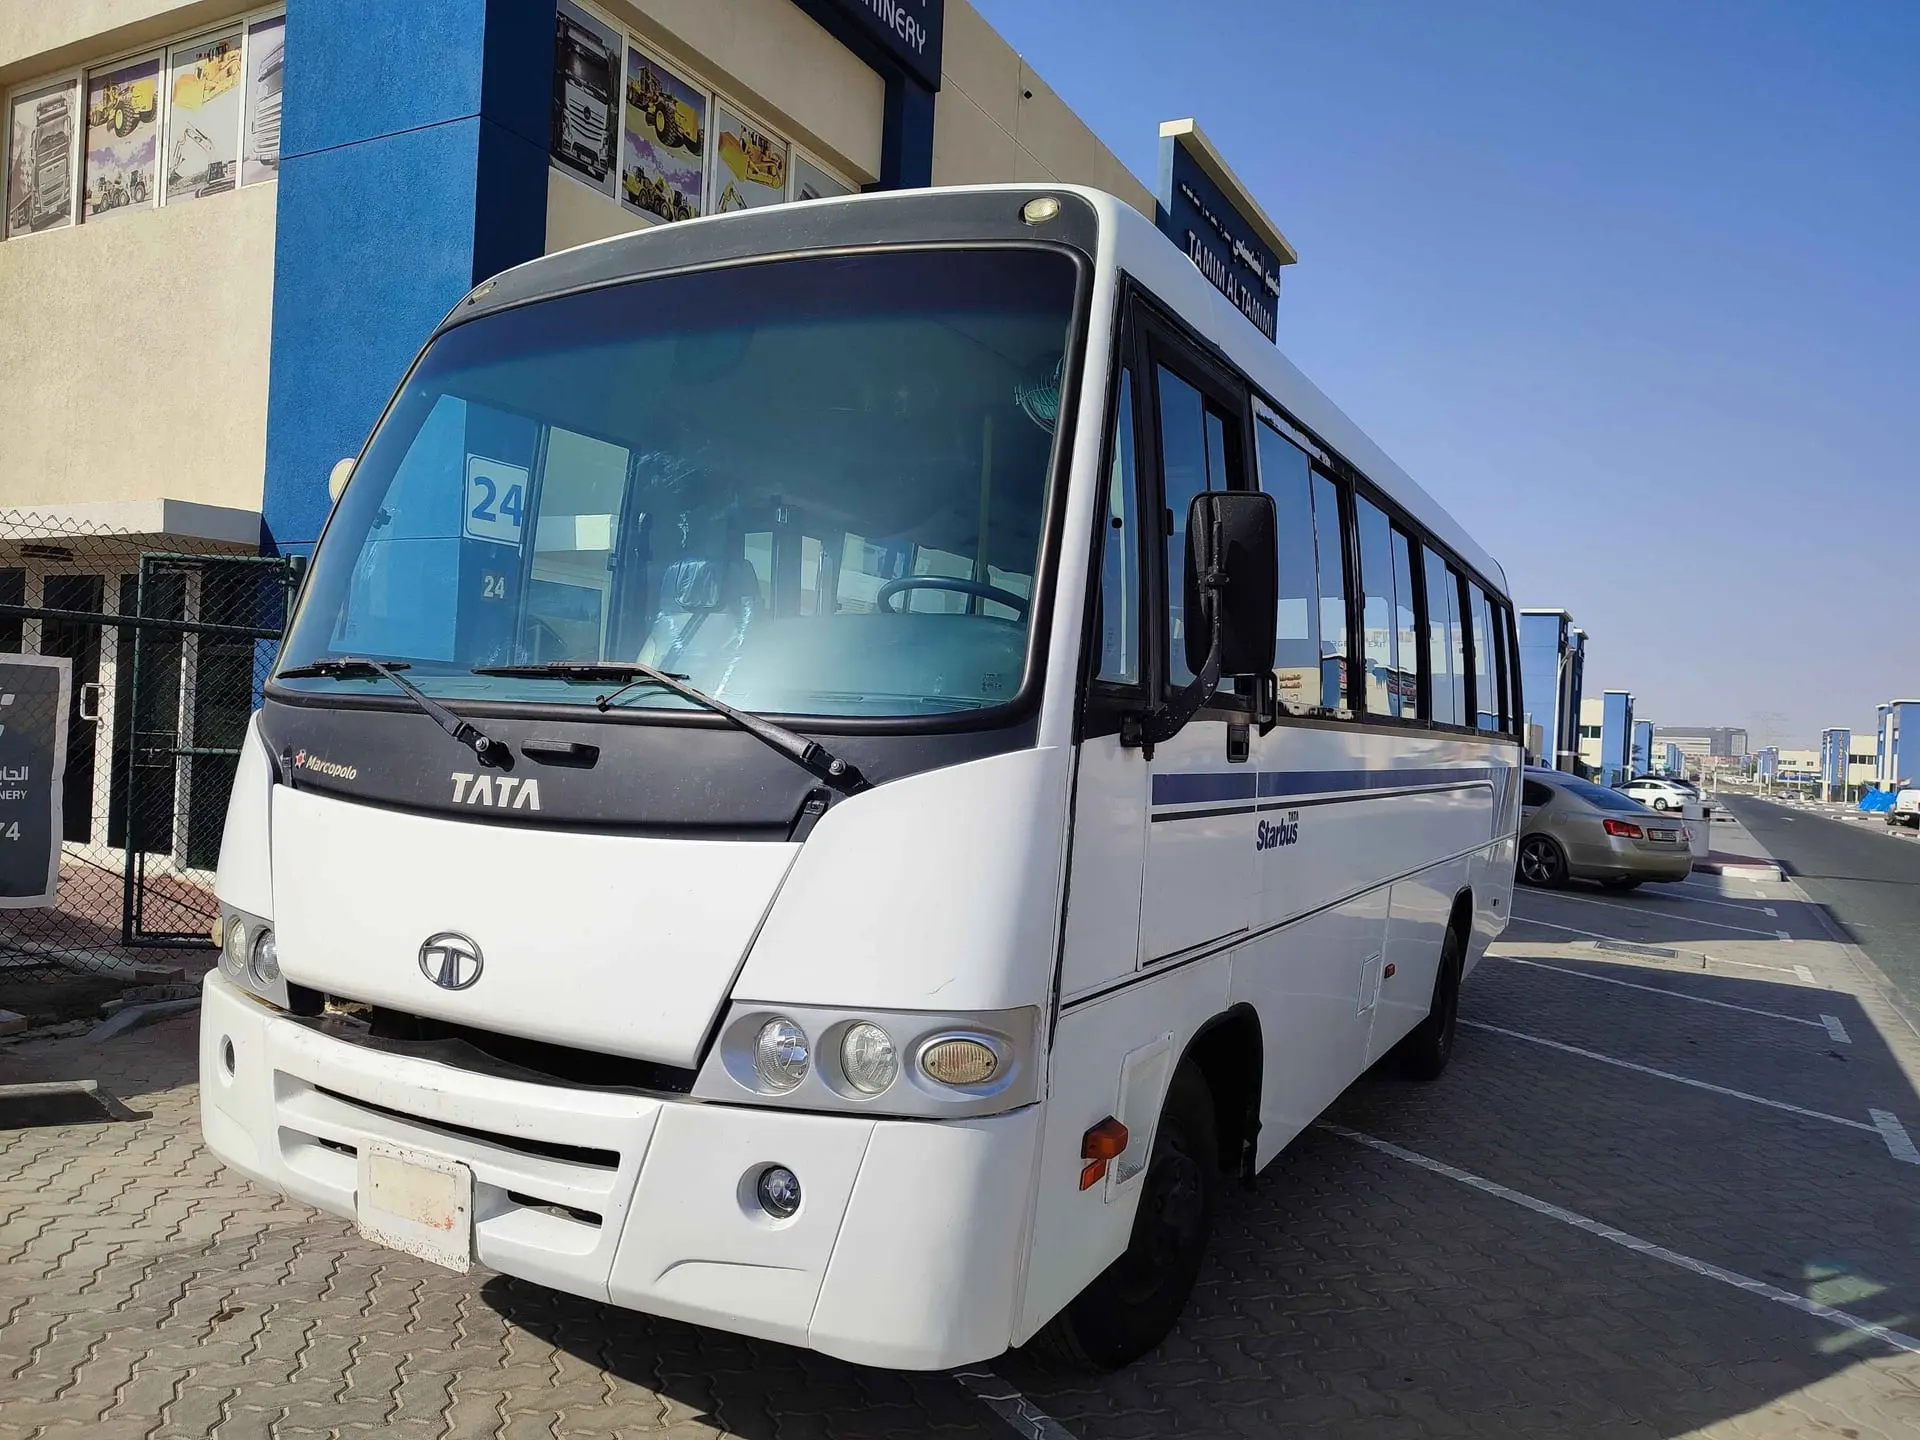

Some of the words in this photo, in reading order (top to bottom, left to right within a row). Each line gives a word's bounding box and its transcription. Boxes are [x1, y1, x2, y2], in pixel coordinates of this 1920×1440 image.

[864, 0, 926, 54] INERY
[1188, 230, 1226, 292] TAMIM
[1227, 274, 1240, 306] AL
[1241, 286, 1273, 339] TAMIMI
[471, 476, 522, 526] 24
[483, 575, 504, 599] 24
[306, 755, 357, 780] Marcopolo
[451, 772, 541, 811] TATA
[1256, 817, 1298, 851] Starbus
